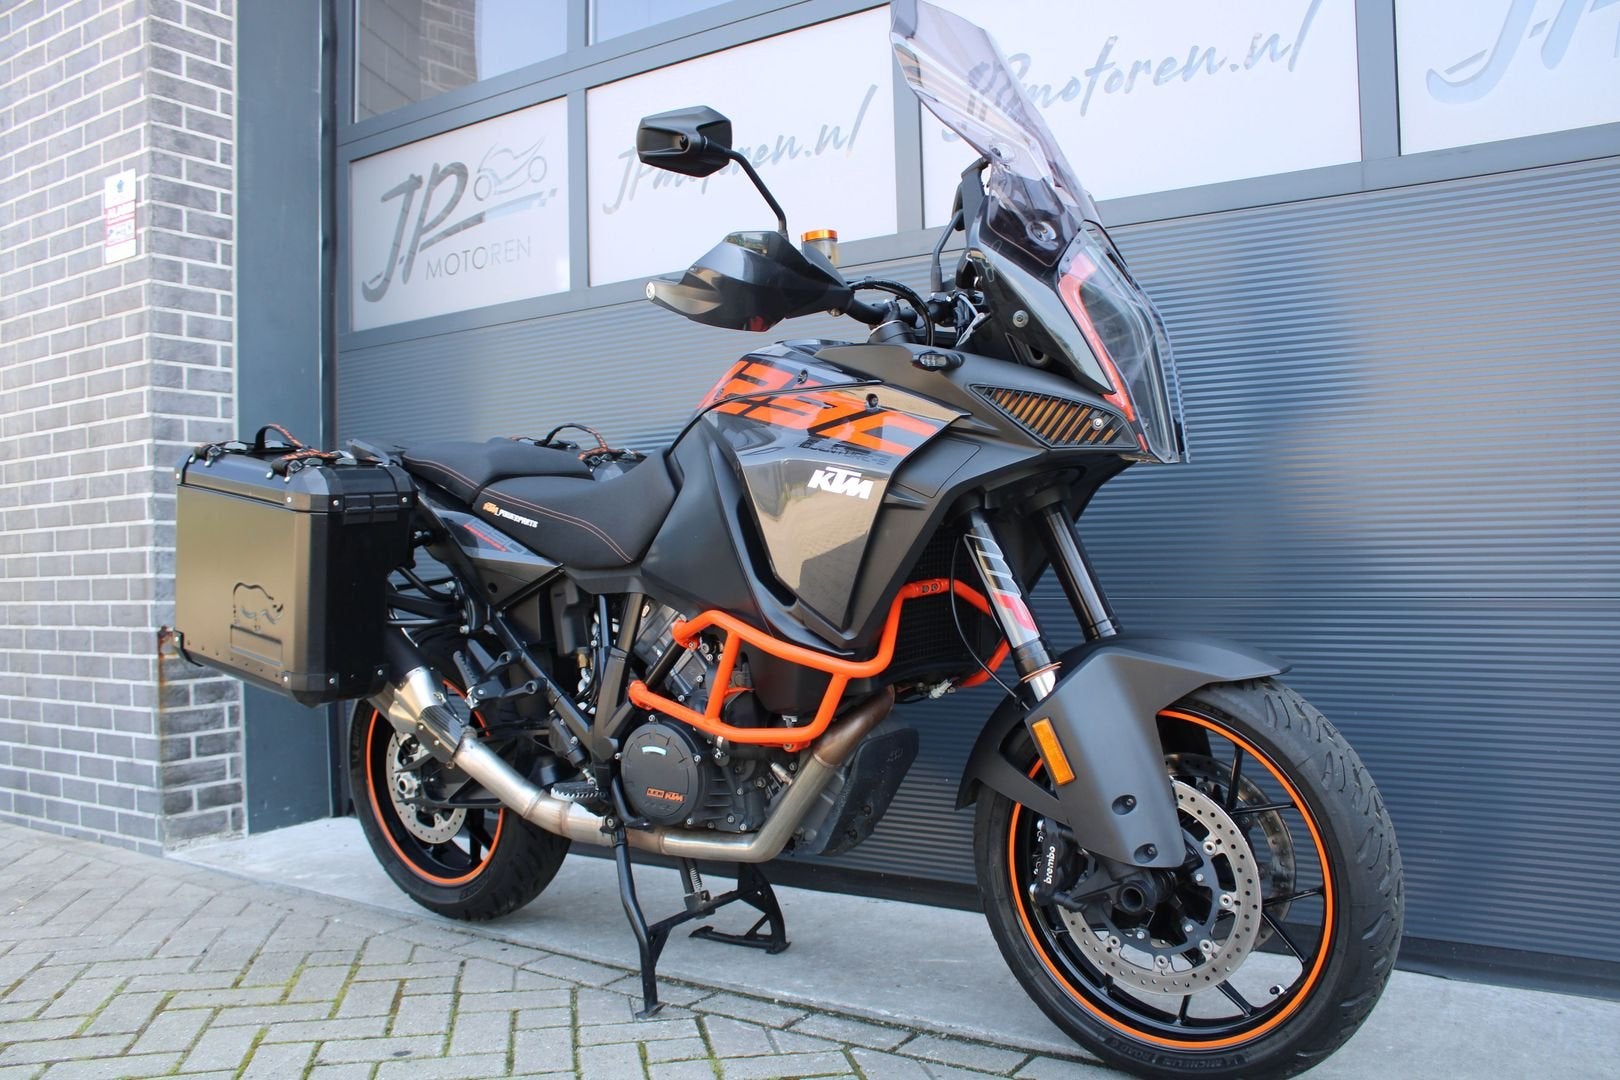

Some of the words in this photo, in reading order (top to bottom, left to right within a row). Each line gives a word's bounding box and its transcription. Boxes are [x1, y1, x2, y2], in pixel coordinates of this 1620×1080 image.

[361, 162, 469, 302] JP
[425, 235, 532, 281] MOTOREN
[807, 466, 874, 500] KTM
[664, 791, 684, 802] KTM
[1043, 845, 1056, 885] brembo
